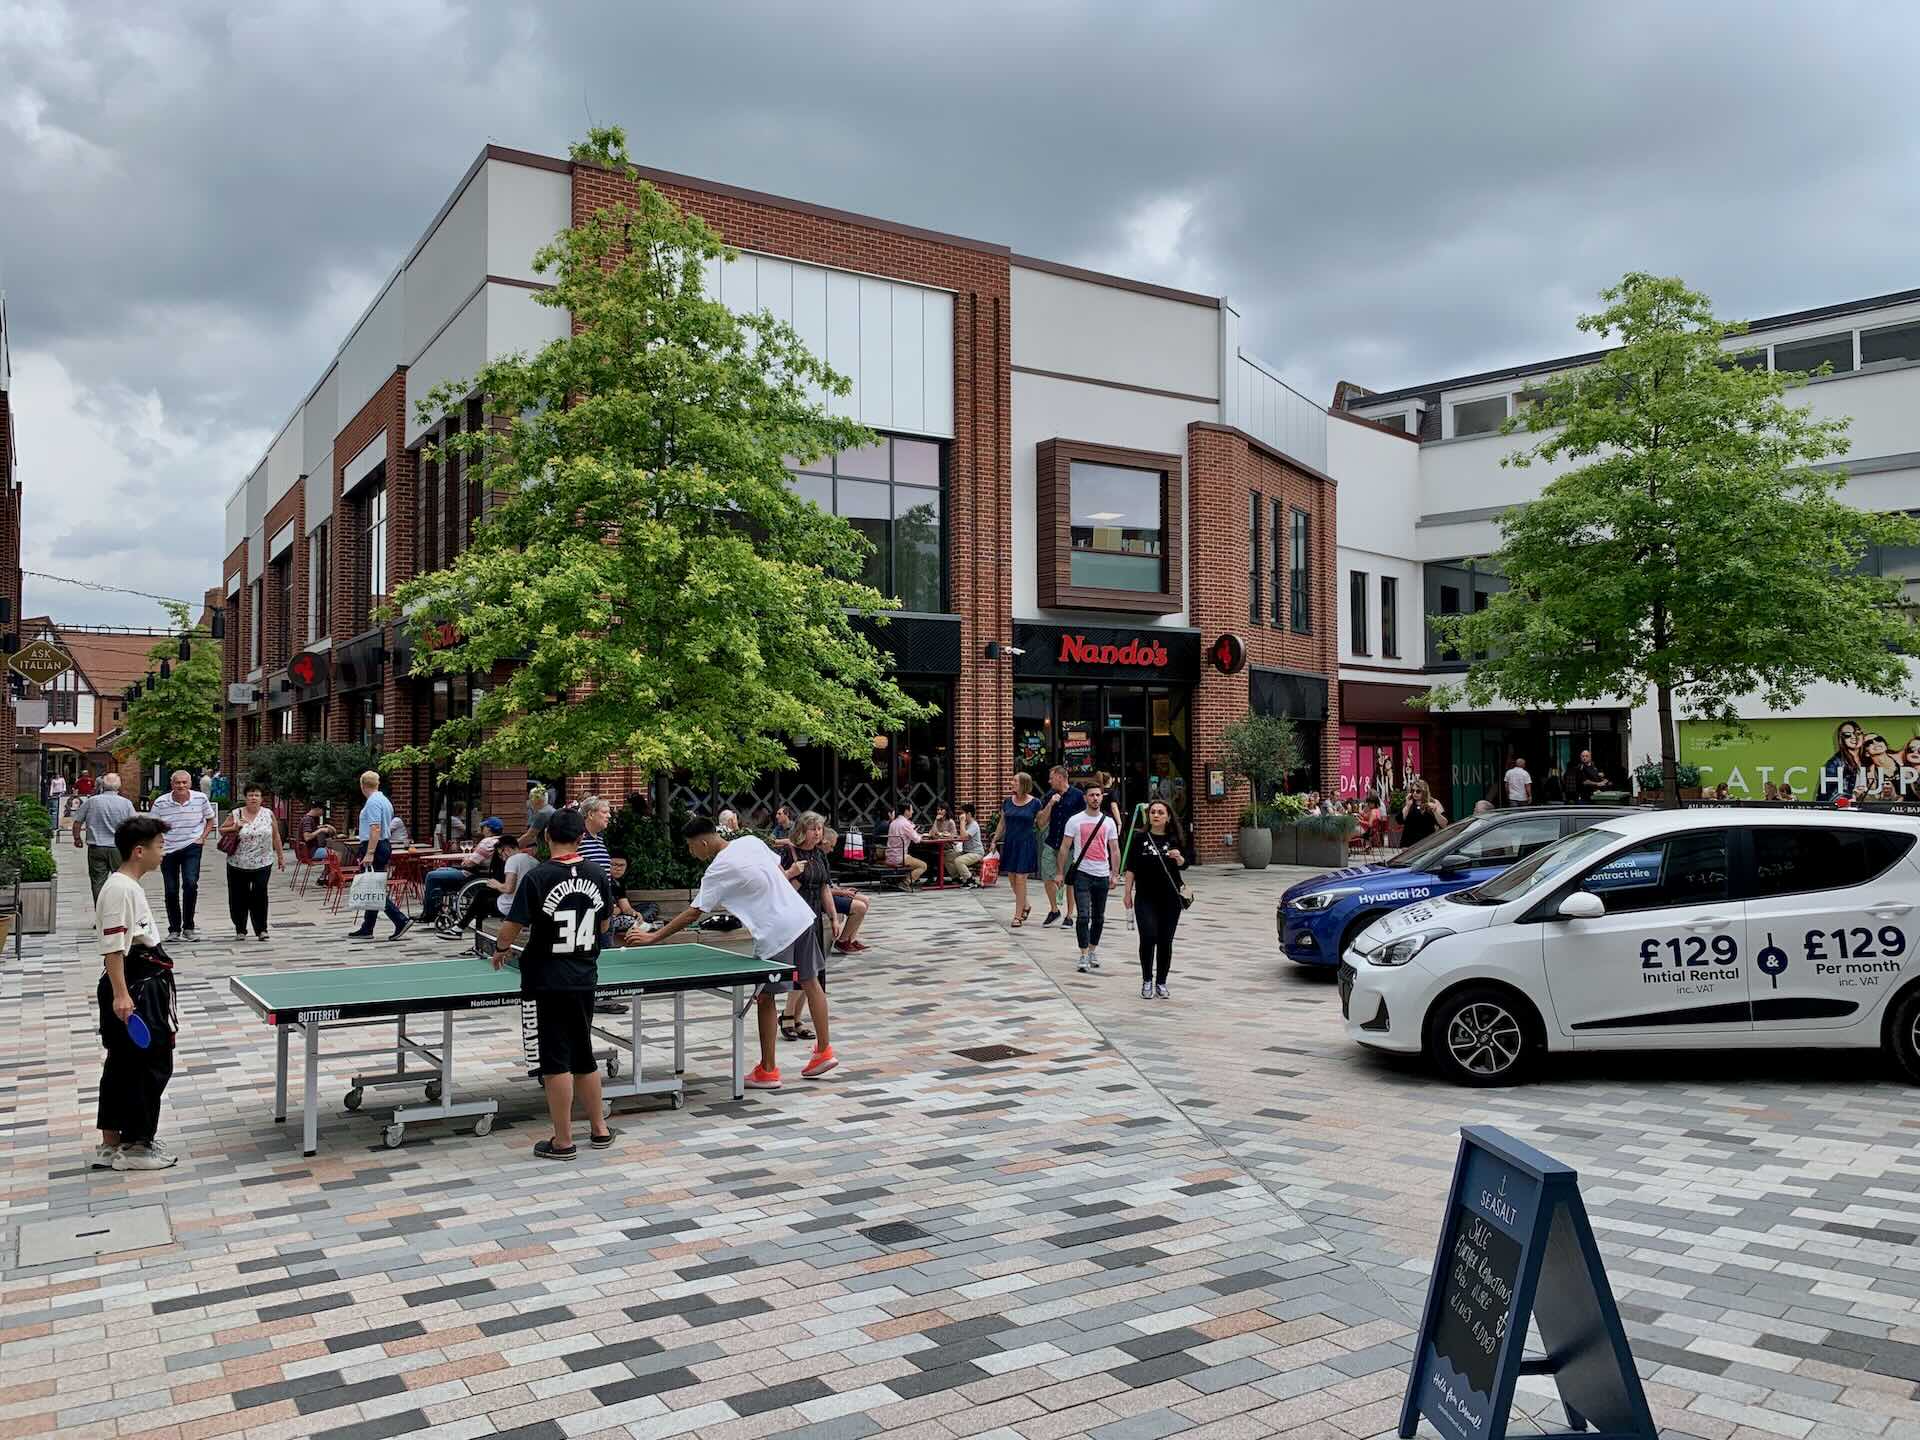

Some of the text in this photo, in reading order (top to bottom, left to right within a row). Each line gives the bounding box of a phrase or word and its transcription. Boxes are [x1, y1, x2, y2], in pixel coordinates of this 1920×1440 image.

[31, 649, 51, 658] ASK
[1058, 634, 1168, 667] Nando's
[20, 660, 61, 670] ITALIAN
[1340, 775, 1364, 793] DA
[1631, 868, 1650, 878] Hire
[352, 893, 385, 901] OUTFIT
[1359, 887, 1409, 904] Hyundai
[552, 908, 595, 954] 34
[1803, 925, 1906, 960] £129
[1639, 935, 1738, 968] £129
[1765, 955, 1780, 967] &
[1816, 960, 1901, 975] Per month
[1643, 968, 1740, 983] Initial Rental
[1860, 976, 1880, 986] VAT
[1696, 983, 1714, 993] VAT
[470, 998, 500, 1008] National
[298, 1009, 340, 1022] BUTTERFLY
[1480, 1190, 1517, 1226] SEASALT
[1468, 1218, 1492, 1251] SALE
[1472, 1320, 1496, 1354] ADDED
[1432, 1372, 1447, 1392] Hello
